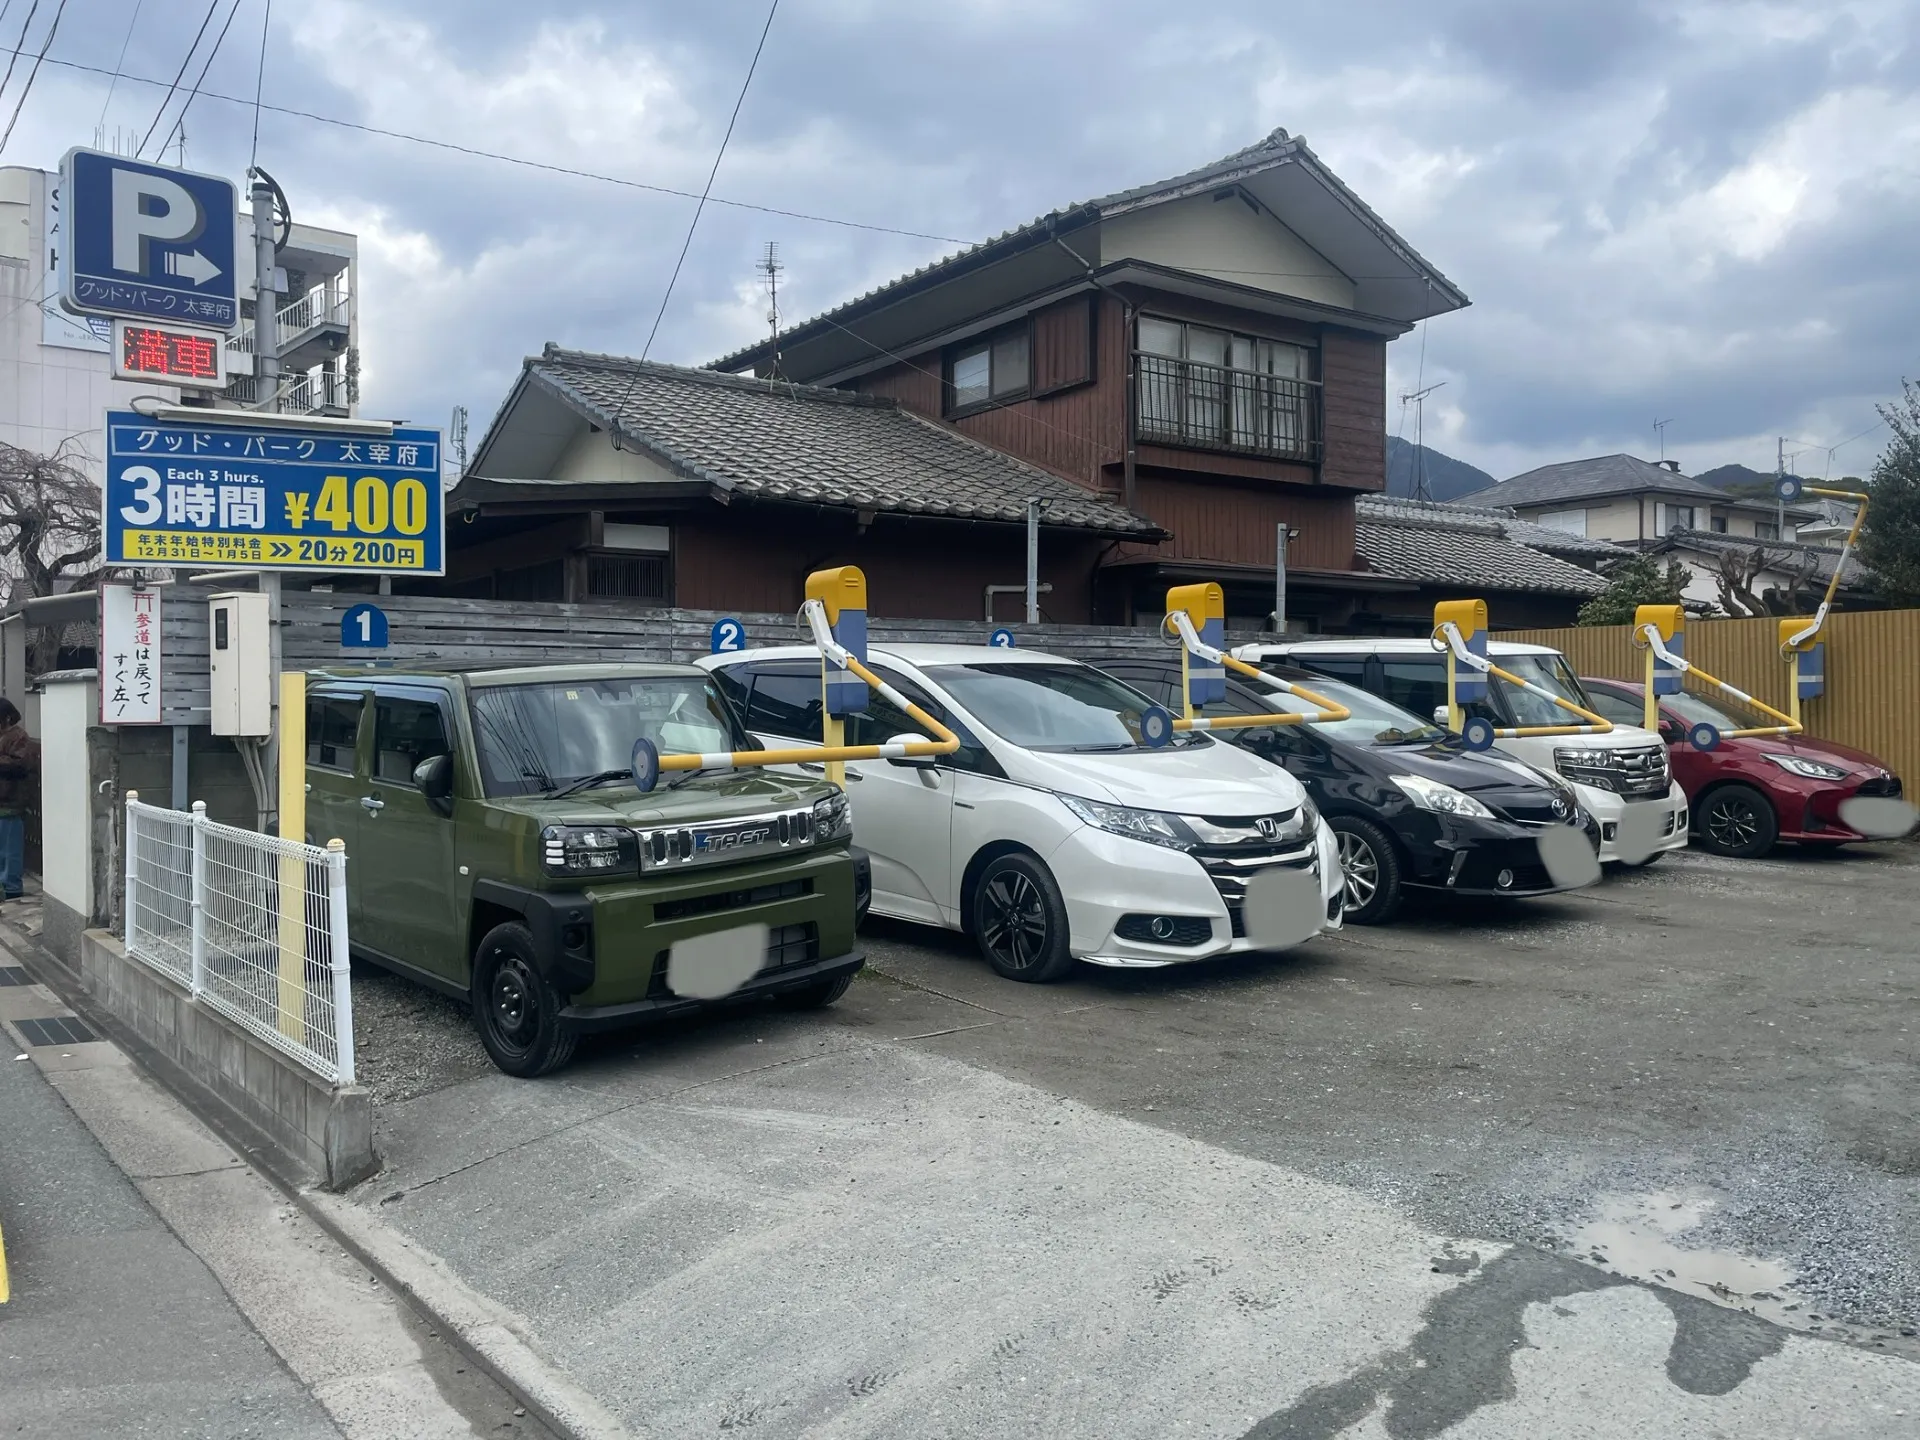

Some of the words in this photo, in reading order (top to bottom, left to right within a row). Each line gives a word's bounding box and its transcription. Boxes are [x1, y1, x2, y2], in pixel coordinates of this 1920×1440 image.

[112, 167, 200, 275] P
[184, 299, 231, 319] 太宰府
[124, 329, 216, 377] 満車
[340, 442, 418, 466] 太宰府
[167, 468, 204, 480] Each
[209, 470, 219, 481] 3
[224, 471, 264, 483] hurs.
[284, 476, 427, 535] ¥400
[138, 534, 261, 549] 年末年始特別料金
[356, 611, 370, 641] 1
[719, 623, 738, 650] 2
[703, 828, 769, 852] TAFT
